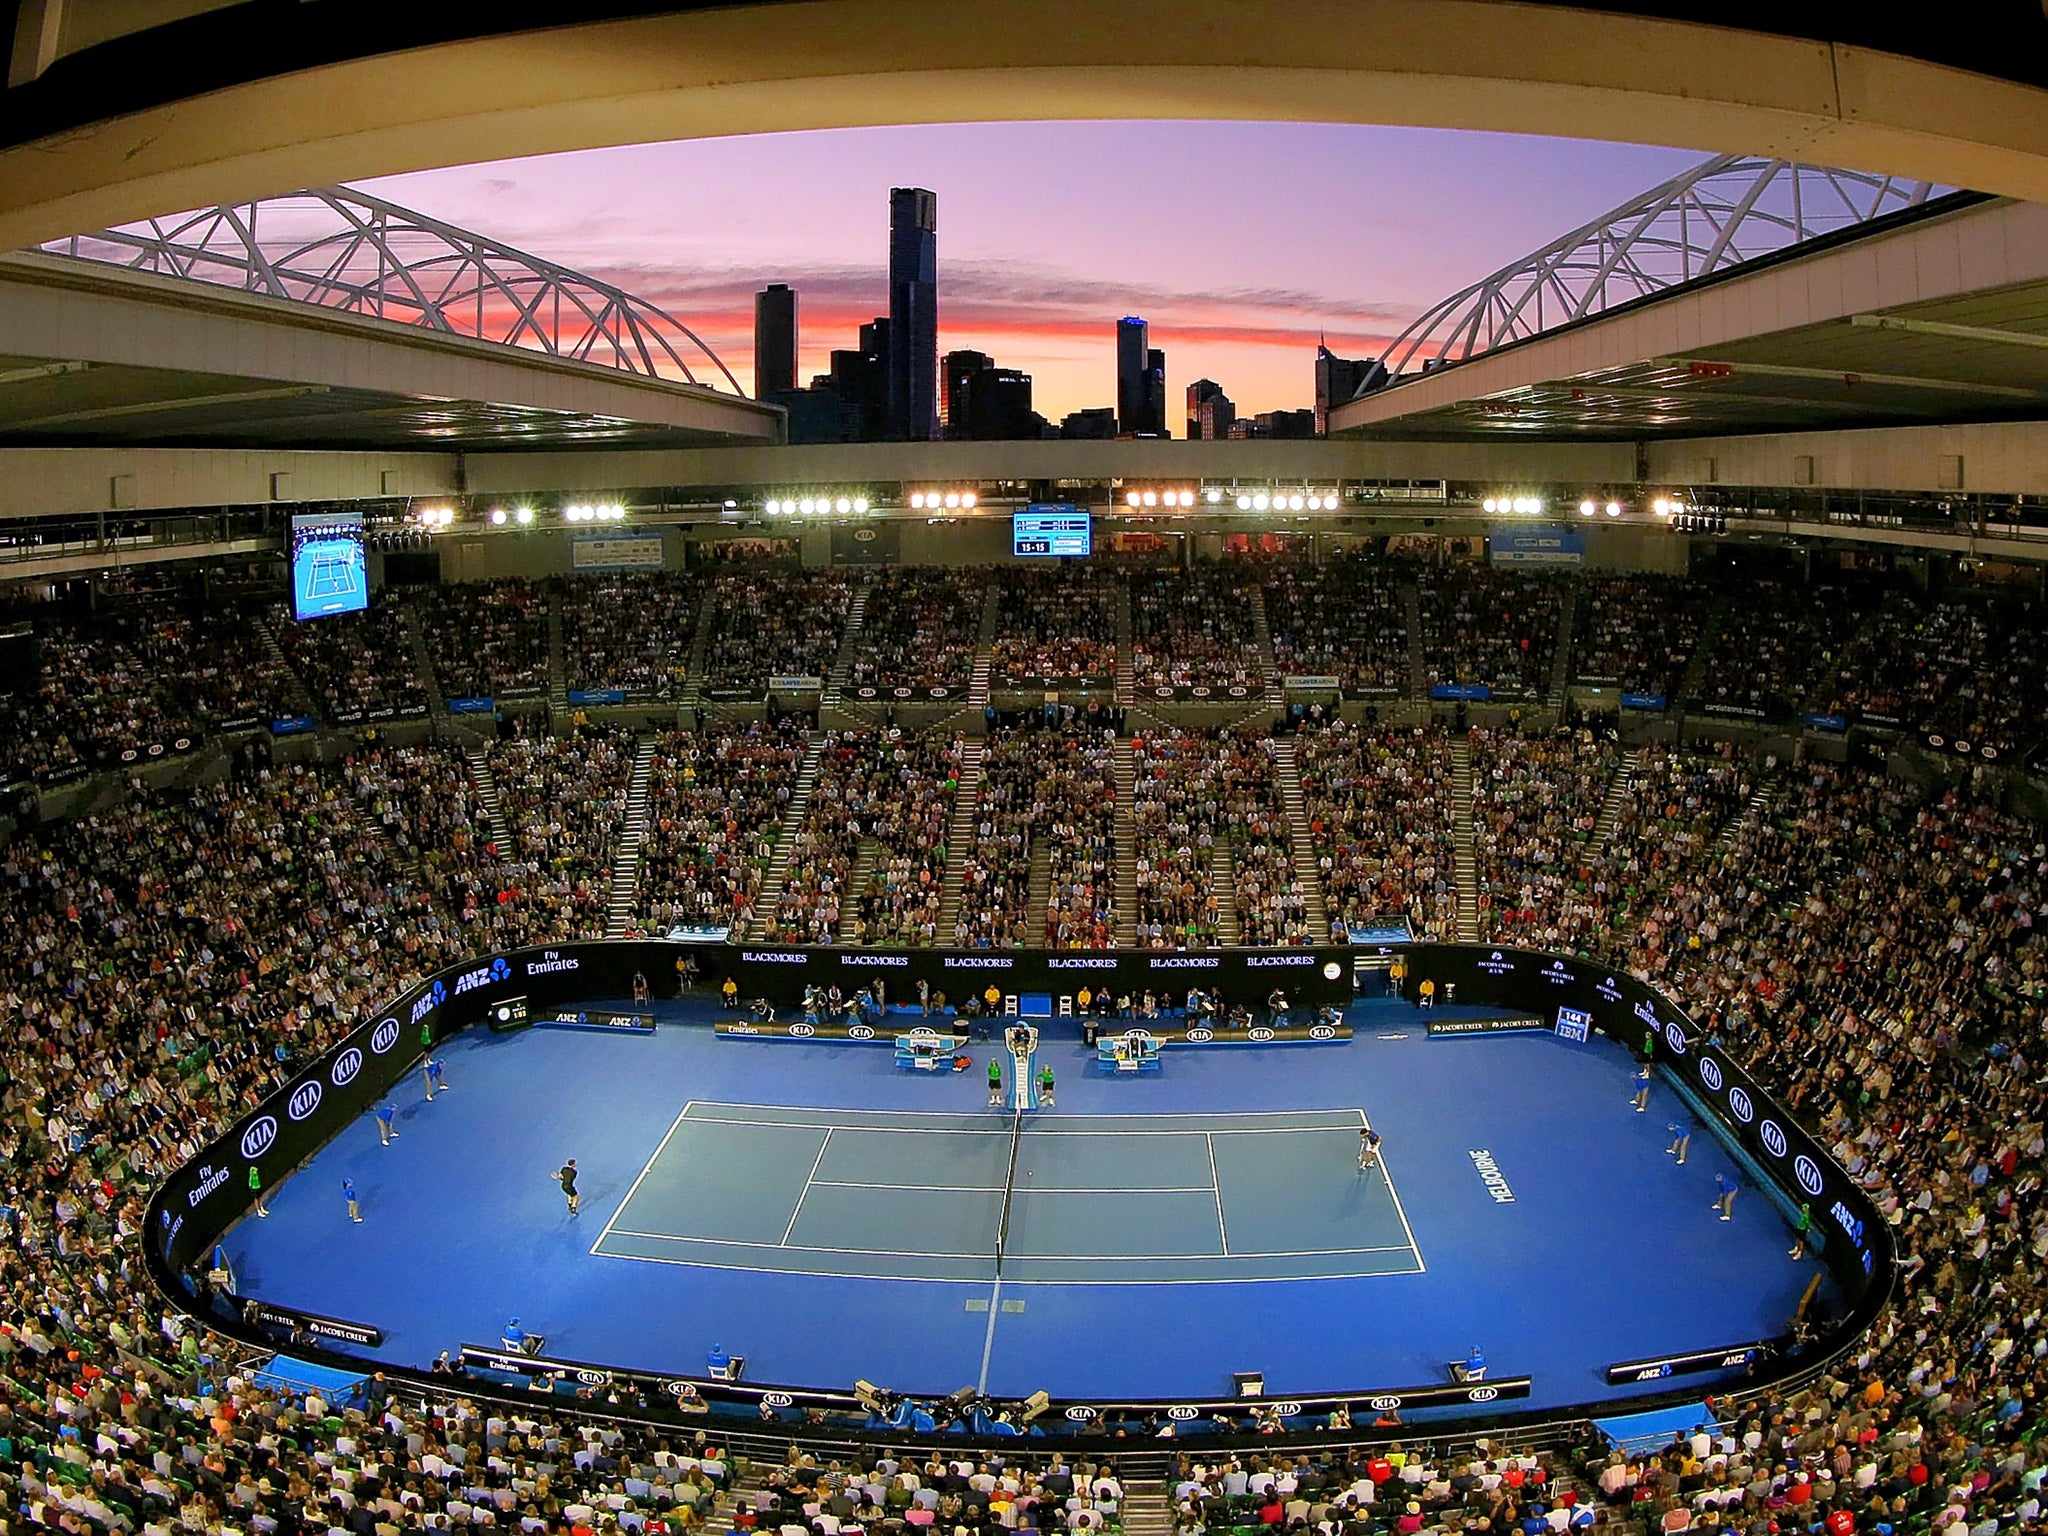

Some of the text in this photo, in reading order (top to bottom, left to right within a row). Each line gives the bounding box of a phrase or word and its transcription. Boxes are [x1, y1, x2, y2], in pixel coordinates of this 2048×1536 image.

[544, 951, 558, 961] Fly
[742, 952, 808, 962] BLACKMORES
[842, 956, 908, 966] BLACKMORES
[1247, 956, 1315, 966] BLACKMORES
[527, 959, 579, 975] Emirates
[944, 958, 1012, 967] BLACKMORES
[1048, 959, 1118, 968] BLACKMORES
[1150, 958, 1219, 968] BLACKMORES
[454, 968, 491, 995] ANZ
[411, 992, 434, 1024] ANZ
[556, 1013, 578, 1023] ANZ
[609, 1017, 631, 1026] ANZ
[1566, 1012, 1581, 1023] 144
[793, 1026, 811, 1034] KIA
[852, 1028, 870, 1036] KIA
[1190, 1030, 1209, 1040] KIA
[1251, 1030, 1271, 1038] KIA
[1312, 1028, 1332, 1037] KIA
[1559, 1025, 1582, 1041] IBM
[376, 1024, 396, 1050] KIA
[1670, 1026, 1682, 1050] KIA
[336, 1054, 358, 1081] KIA
[1704, 1060, 1718, 1086] KIA
[294, 1086, 317, 1116] KIA
[1732, 1090, 1748, 1118] KIA
[246, 1122, 272, 1154] KIA
[1764, 1122, 1781, 1153] KIA
[1468, 1150, 1516, 1202] MELBOURNE
[1798, 1158, 1817, 1191] KIA
[188, 1166, 230, 1207] Emirates
[346, 1332, 368, 1342] CREEK
[1722, 1354, 1744, 1366] ANZ
[582, 1372, 600, 1382] KIA
[1636, 1369, 1660, 1380] ANZ
[768, 1394, 786, 1404] KIA
[1474, 1390, 1493, 1400] KIA
[1376, 1398, 1394, 1408] KIA
[1070, 1409, 1091, 1418] KIA
[1174, 1408, 1193, 1417] KIA
